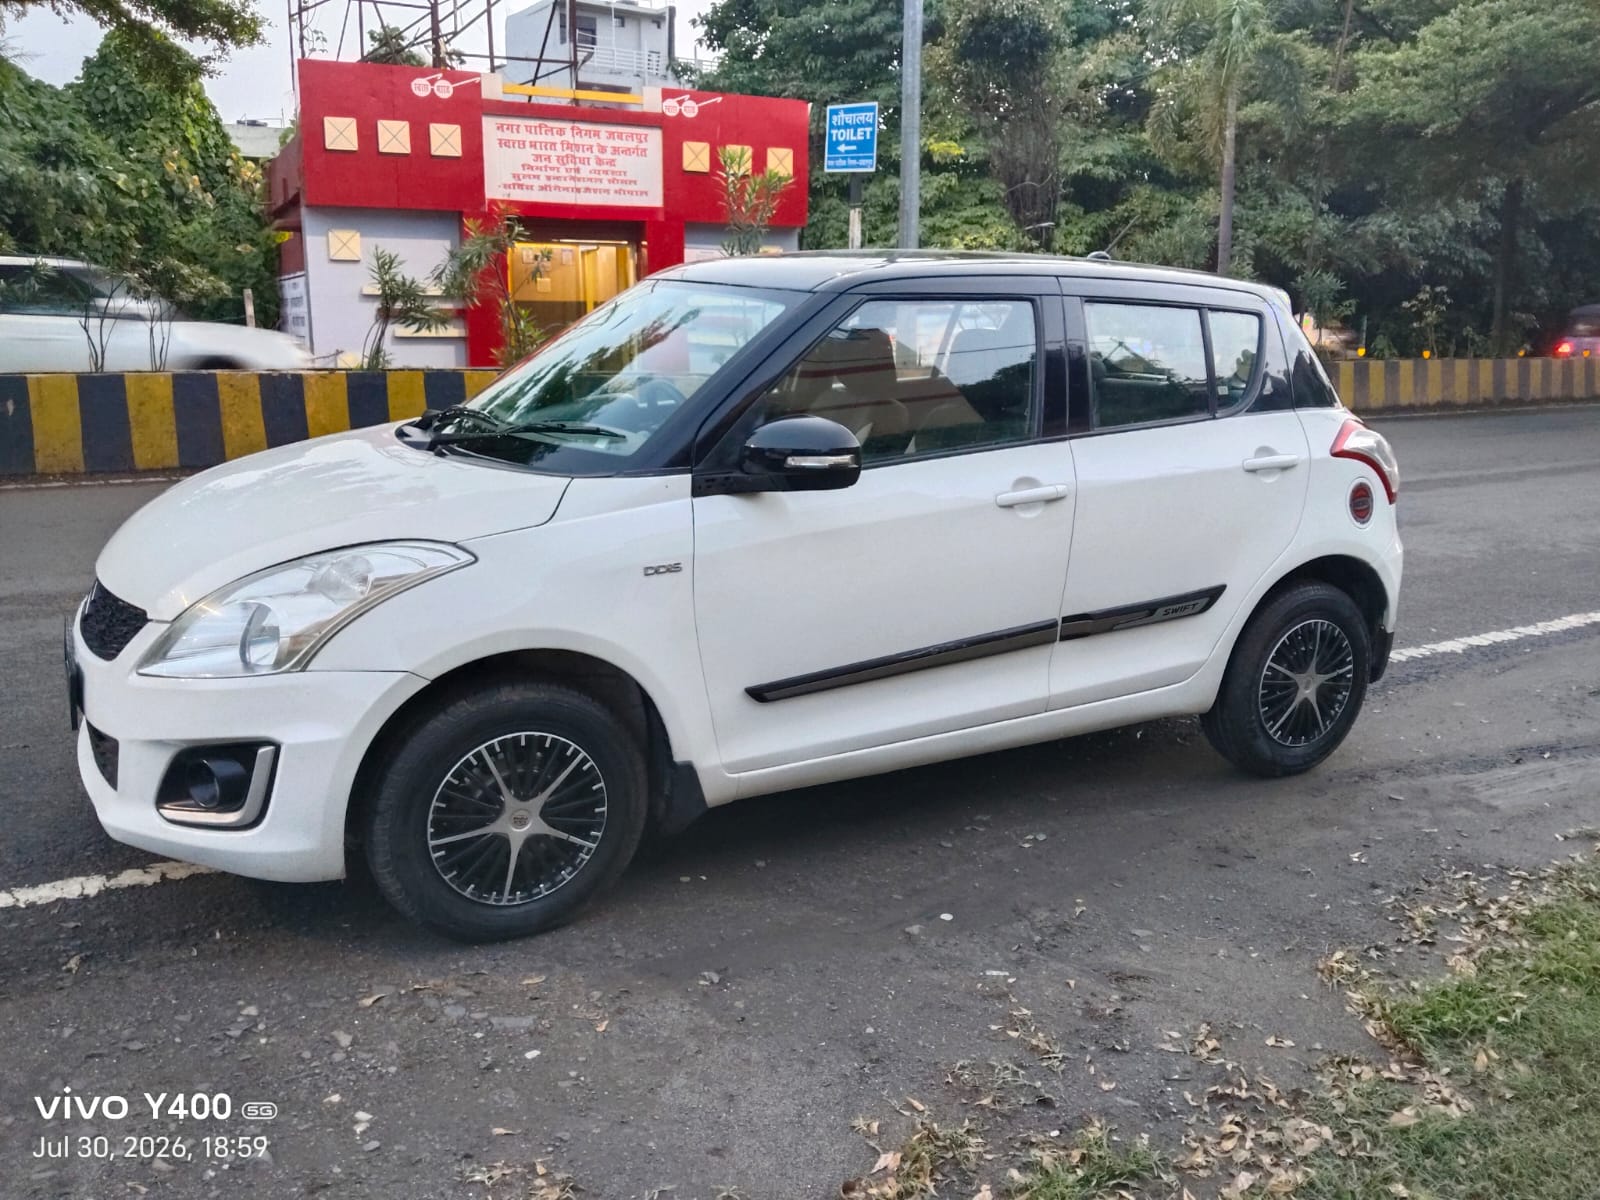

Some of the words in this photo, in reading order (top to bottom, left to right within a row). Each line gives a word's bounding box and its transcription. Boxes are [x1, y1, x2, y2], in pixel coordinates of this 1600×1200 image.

[496, 122, 521, 134] नगर
[524, 123, 567, 136] पालिक
[570, 125, 601, 139] निगम
[605, 130, 649, 143] जबलपुर
[831, 127, 873, 142] TOILET
[528, 140, 557, 151] भारत
[596, 143, 608, 154] के
[531, 153, 552, 163] जन
[554, 154, 591, 166] सुविधा
[1162, 602, 1200, 616] SWIFT
